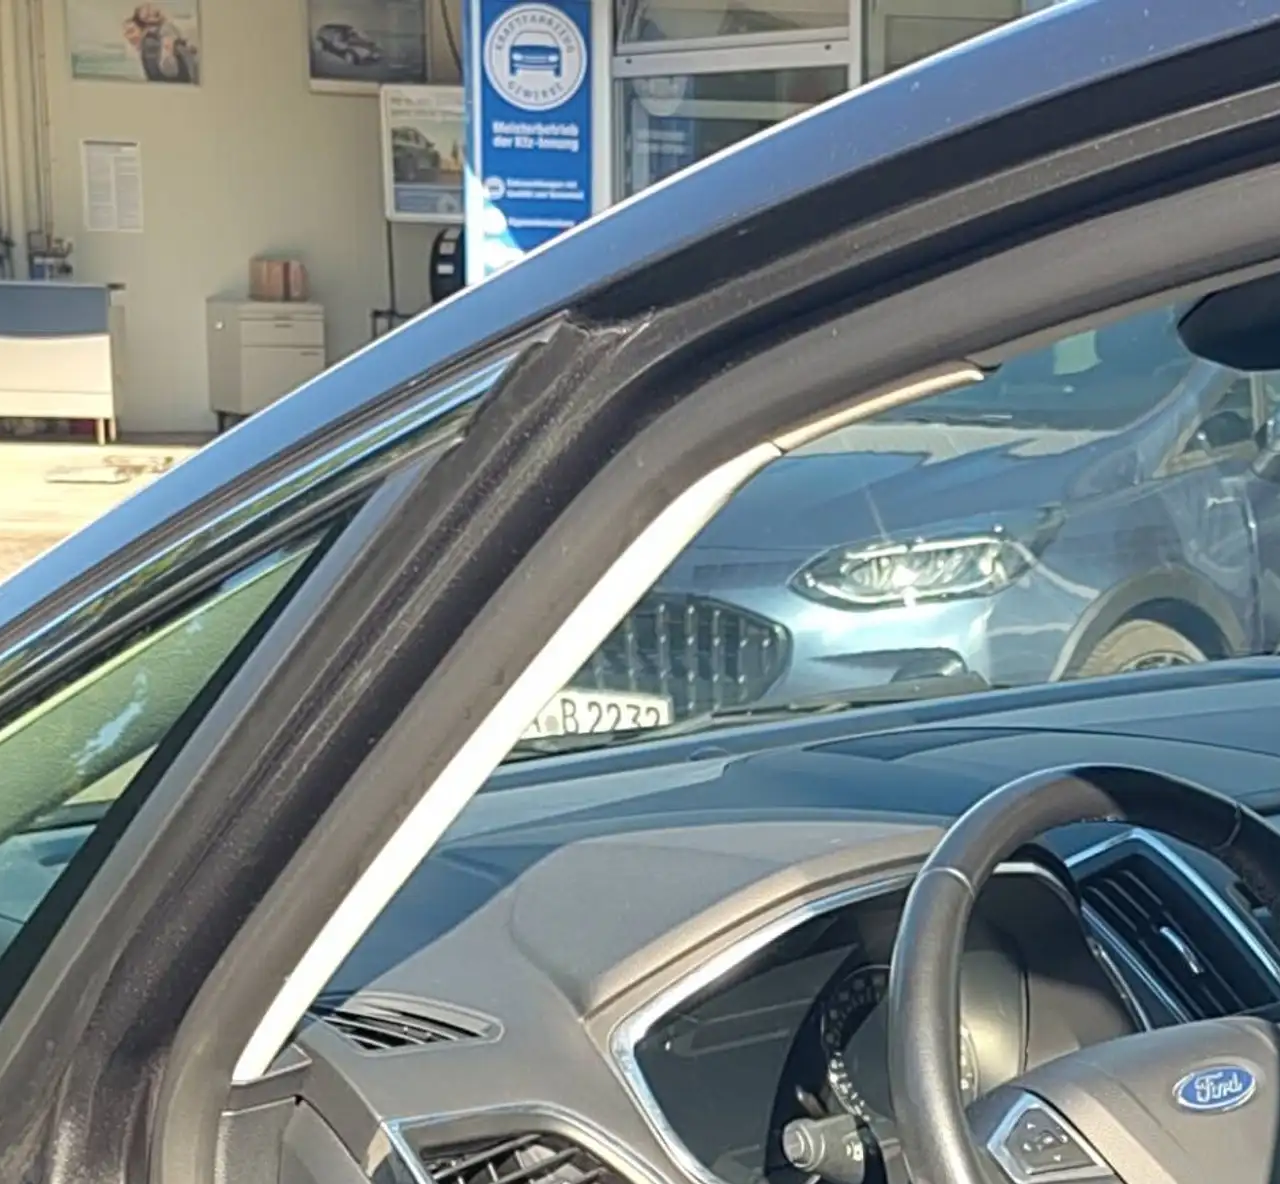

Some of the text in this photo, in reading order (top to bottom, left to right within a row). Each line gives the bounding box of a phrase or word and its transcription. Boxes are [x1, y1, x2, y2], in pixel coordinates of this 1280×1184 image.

[492, 120, 580, 137] Meisterbetrieb
[492, 135, 513, 149] der
[1193, 1070, 1244, 1103] Ford
